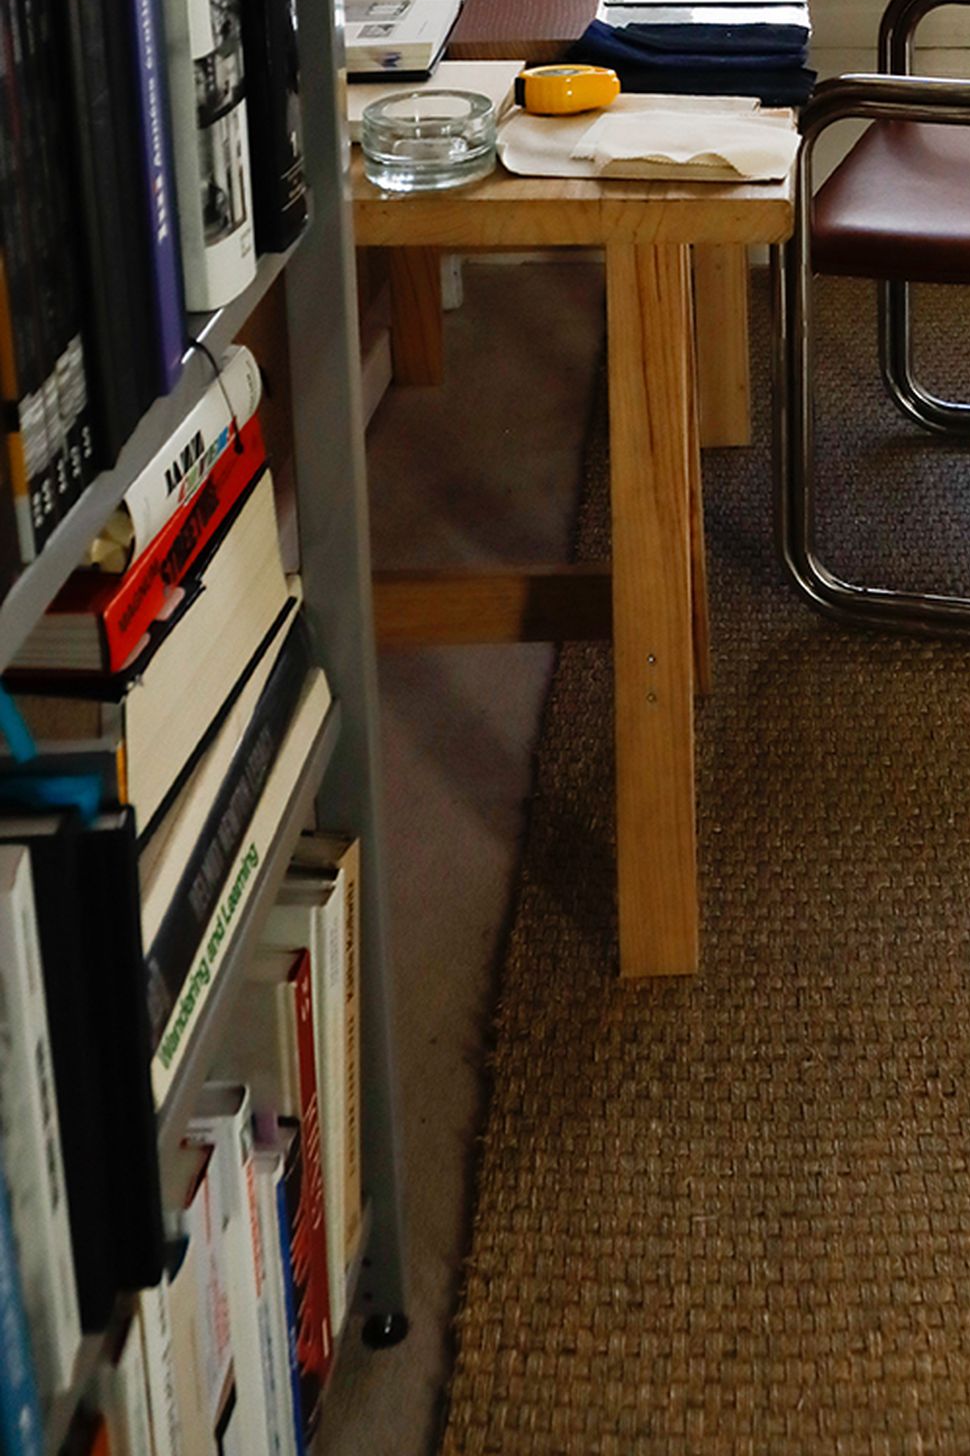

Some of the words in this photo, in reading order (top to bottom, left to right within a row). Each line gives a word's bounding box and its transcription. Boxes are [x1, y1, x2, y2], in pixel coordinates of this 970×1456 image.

[148, 76, 163, 170] Années
[157, 957, 211, 1070] Wandering
[206, 915, 228, 965] and
[218, 840, 260, 928] Learning
